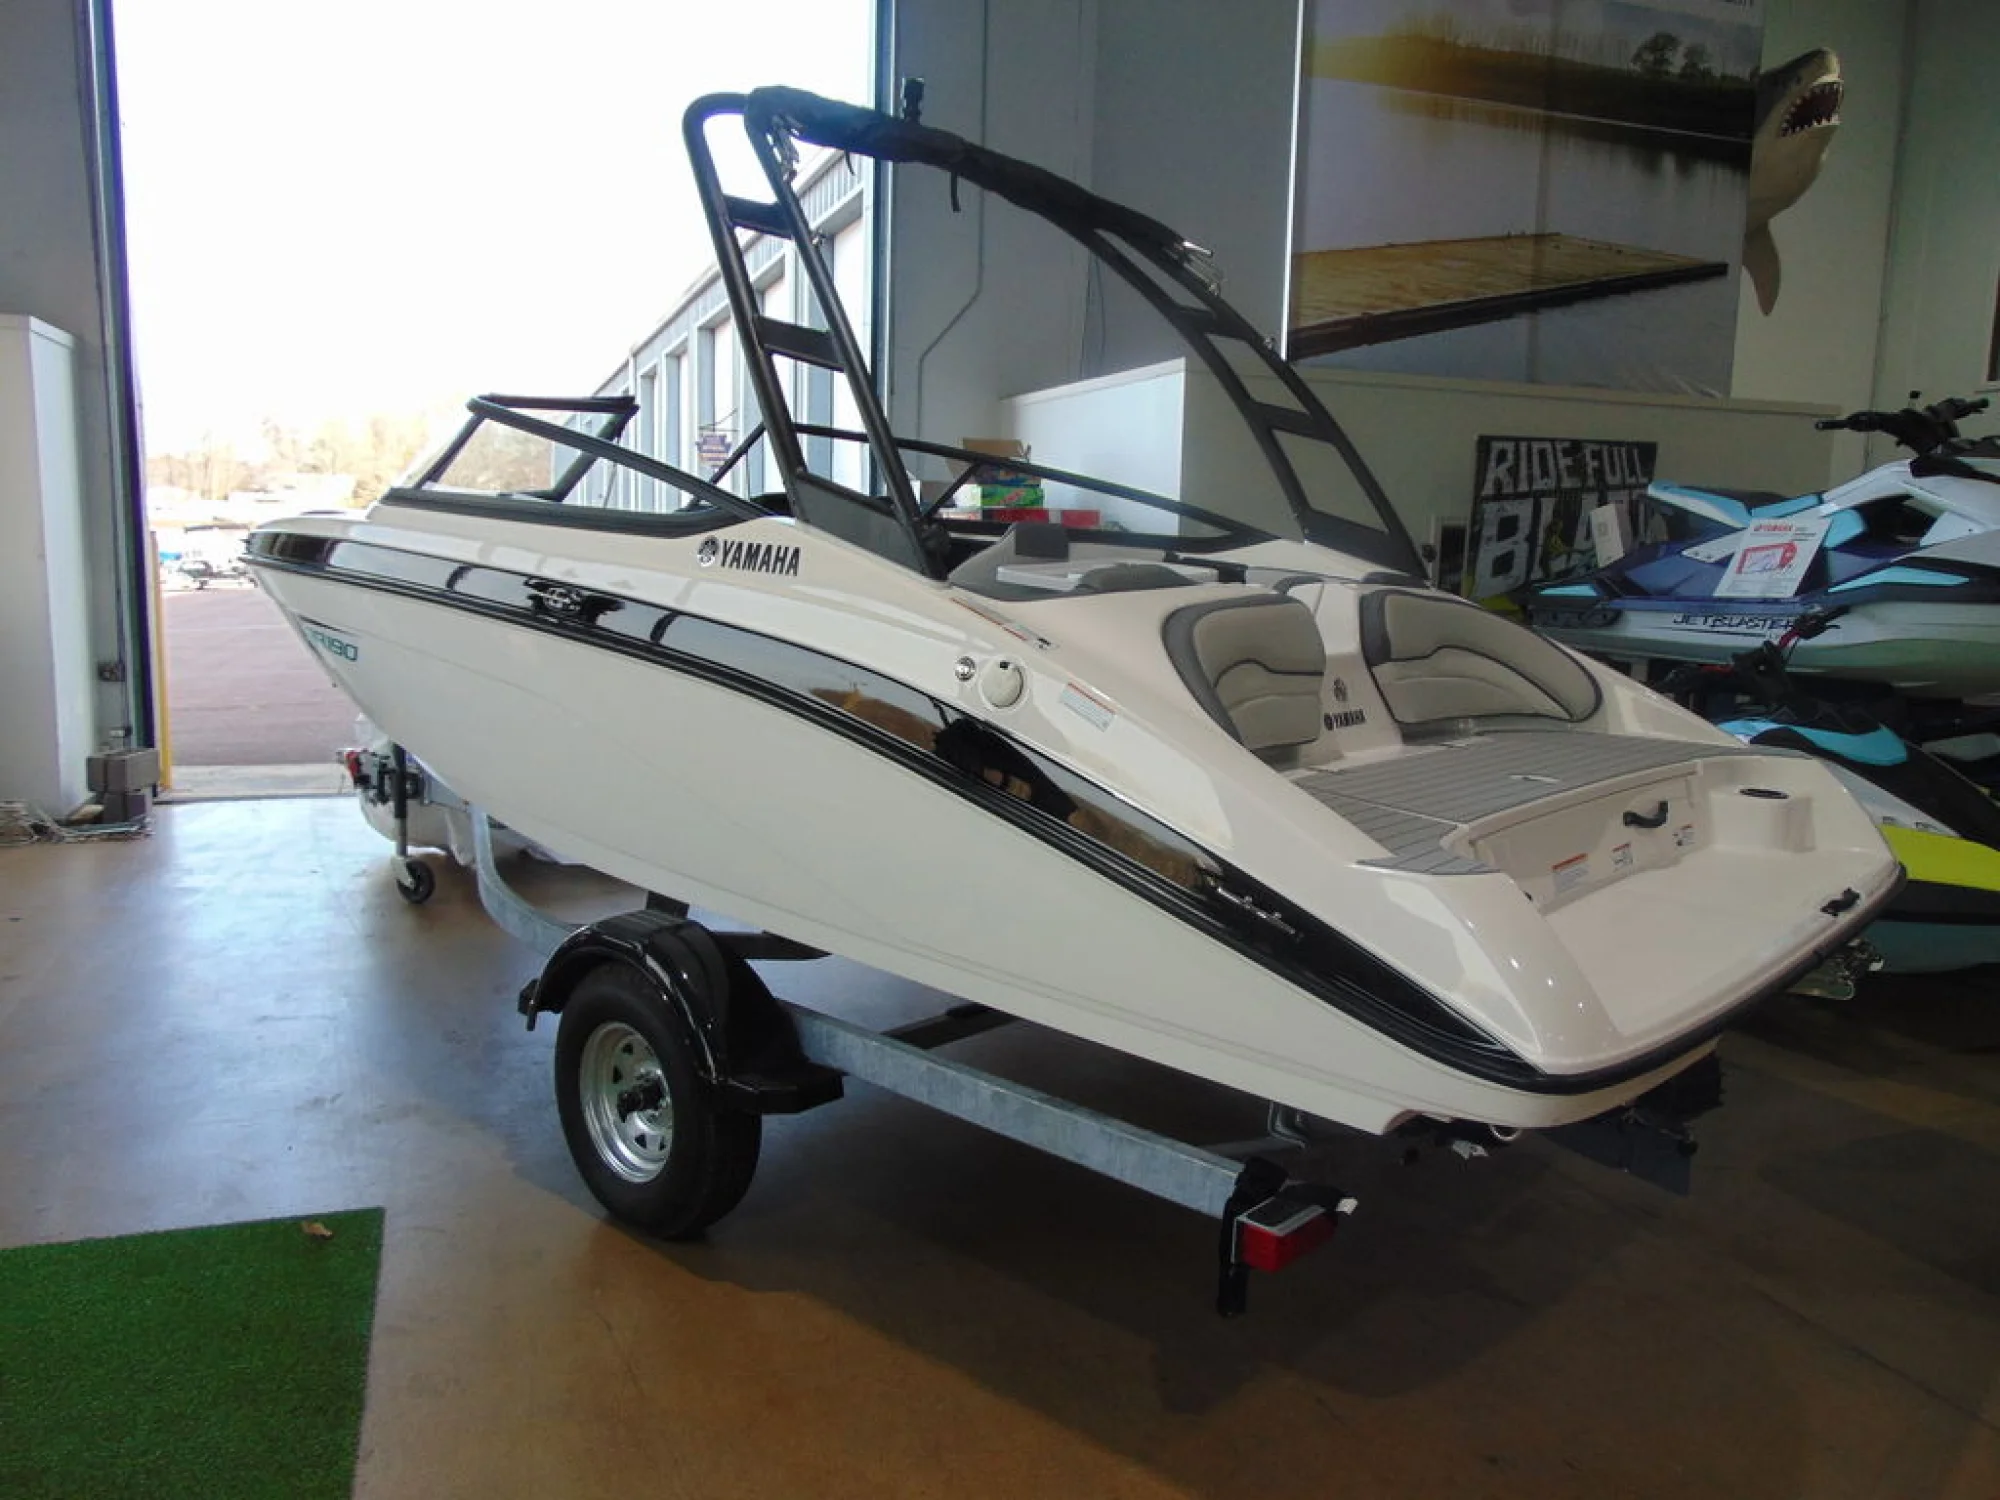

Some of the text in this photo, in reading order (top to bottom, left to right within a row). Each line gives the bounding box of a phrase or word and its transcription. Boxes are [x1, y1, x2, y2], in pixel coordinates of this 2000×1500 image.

[1482, 440, 1649, 496] RIDE FULL
[720, 539, 800, 577] YAMAHA
[1332, 709, 1366, 728] YAMAHA
